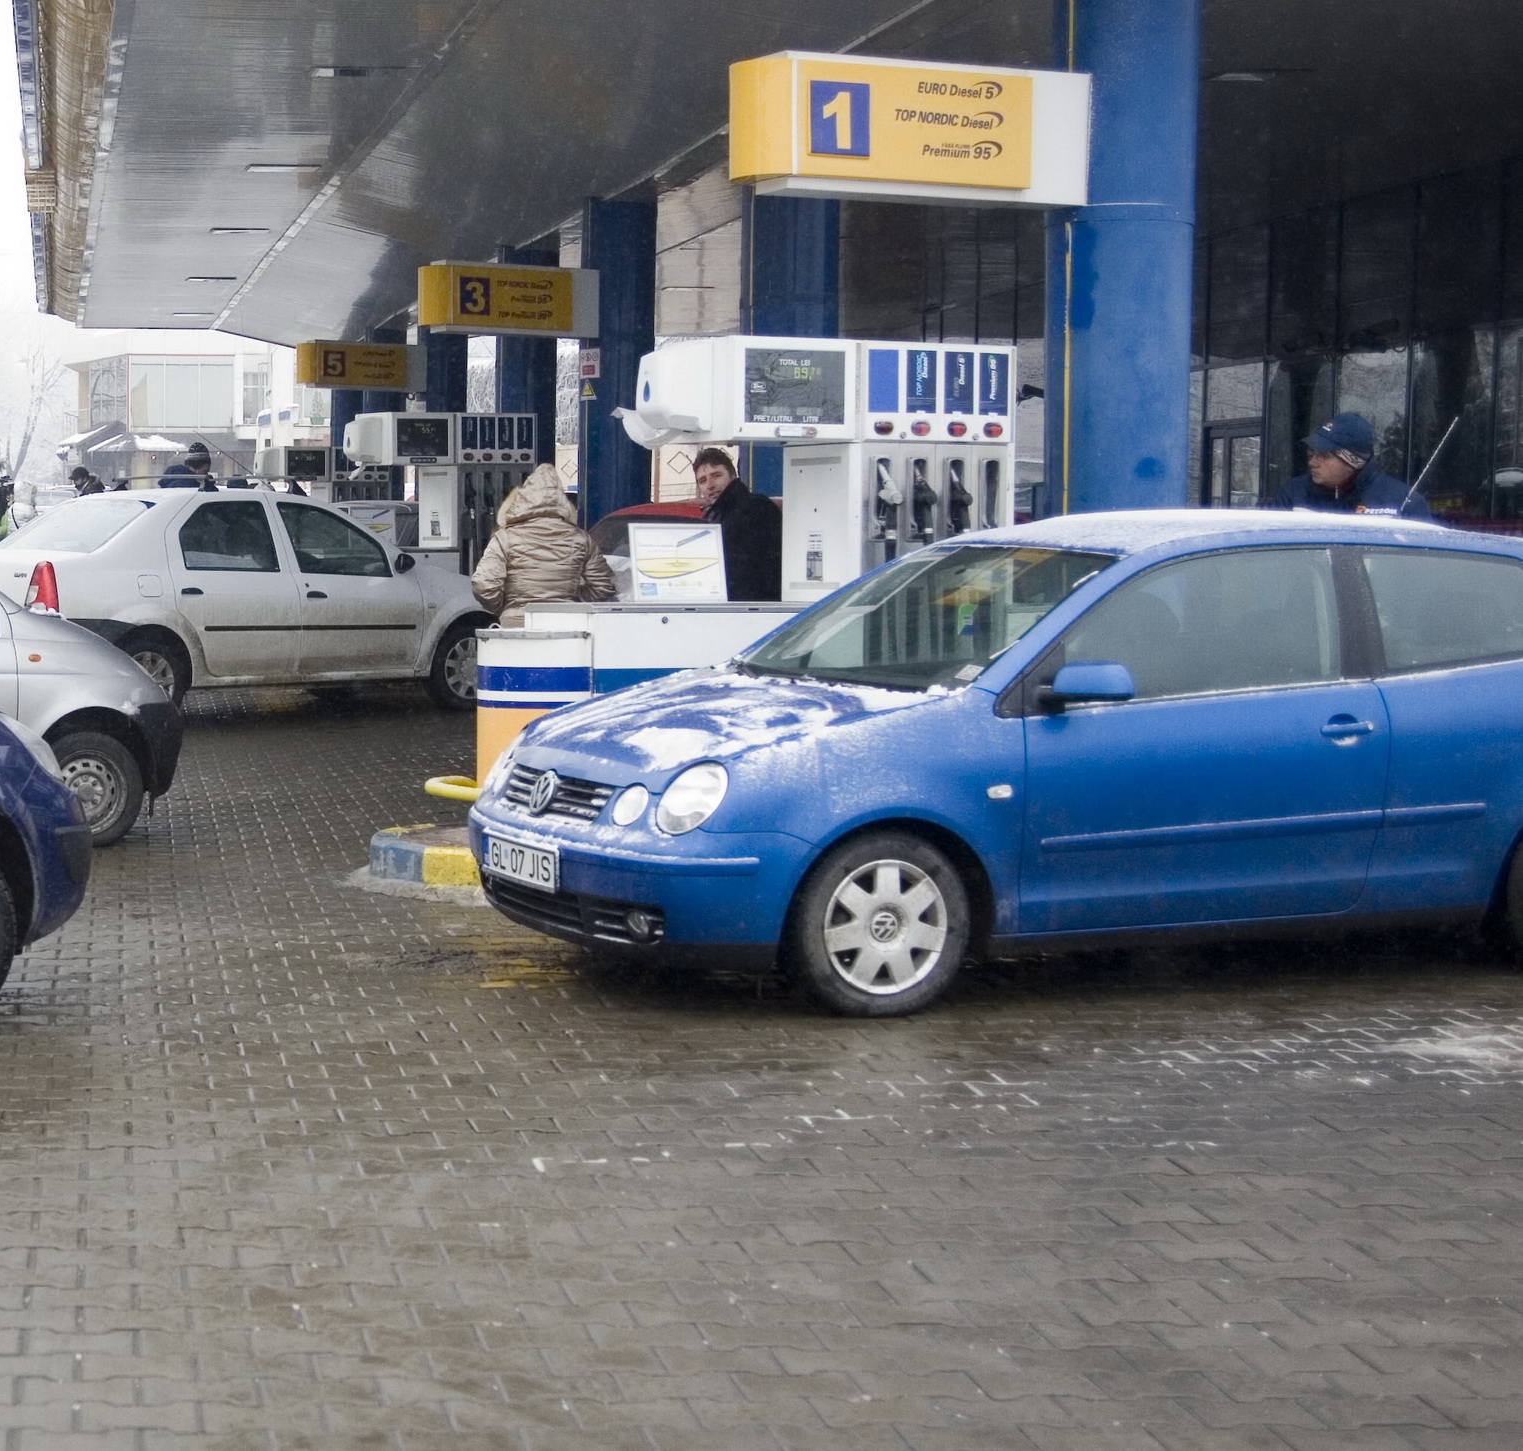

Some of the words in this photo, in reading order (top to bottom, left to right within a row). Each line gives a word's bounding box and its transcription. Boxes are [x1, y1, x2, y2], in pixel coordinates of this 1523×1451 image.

[918, 82, 948, 95] EURO
[950, 84, 982, 98] Diesel
[984, 86, 994, 100] 5
[822, 91, 851, 149] 1
[895, 108, 916, 122] TOP
[918, 111, 959, 126] NORDIC
[960, 116, 994, 130] Diesel
[922, 144, 970, 158] Premium
[972, 146, 992, 160] 95
[465, 281, 486, 312] 3
[326, 353, 343, 376] 5
[779, 358, 798, 366] TOTAL
[958, 364, 966, 386] Diesel
[754, 414, 792, 422] PRET/LITRU
[492, 842, 506, 870] GL
[510, 848, 524, 875] 07
[529, 853, 551, 882] JIS
